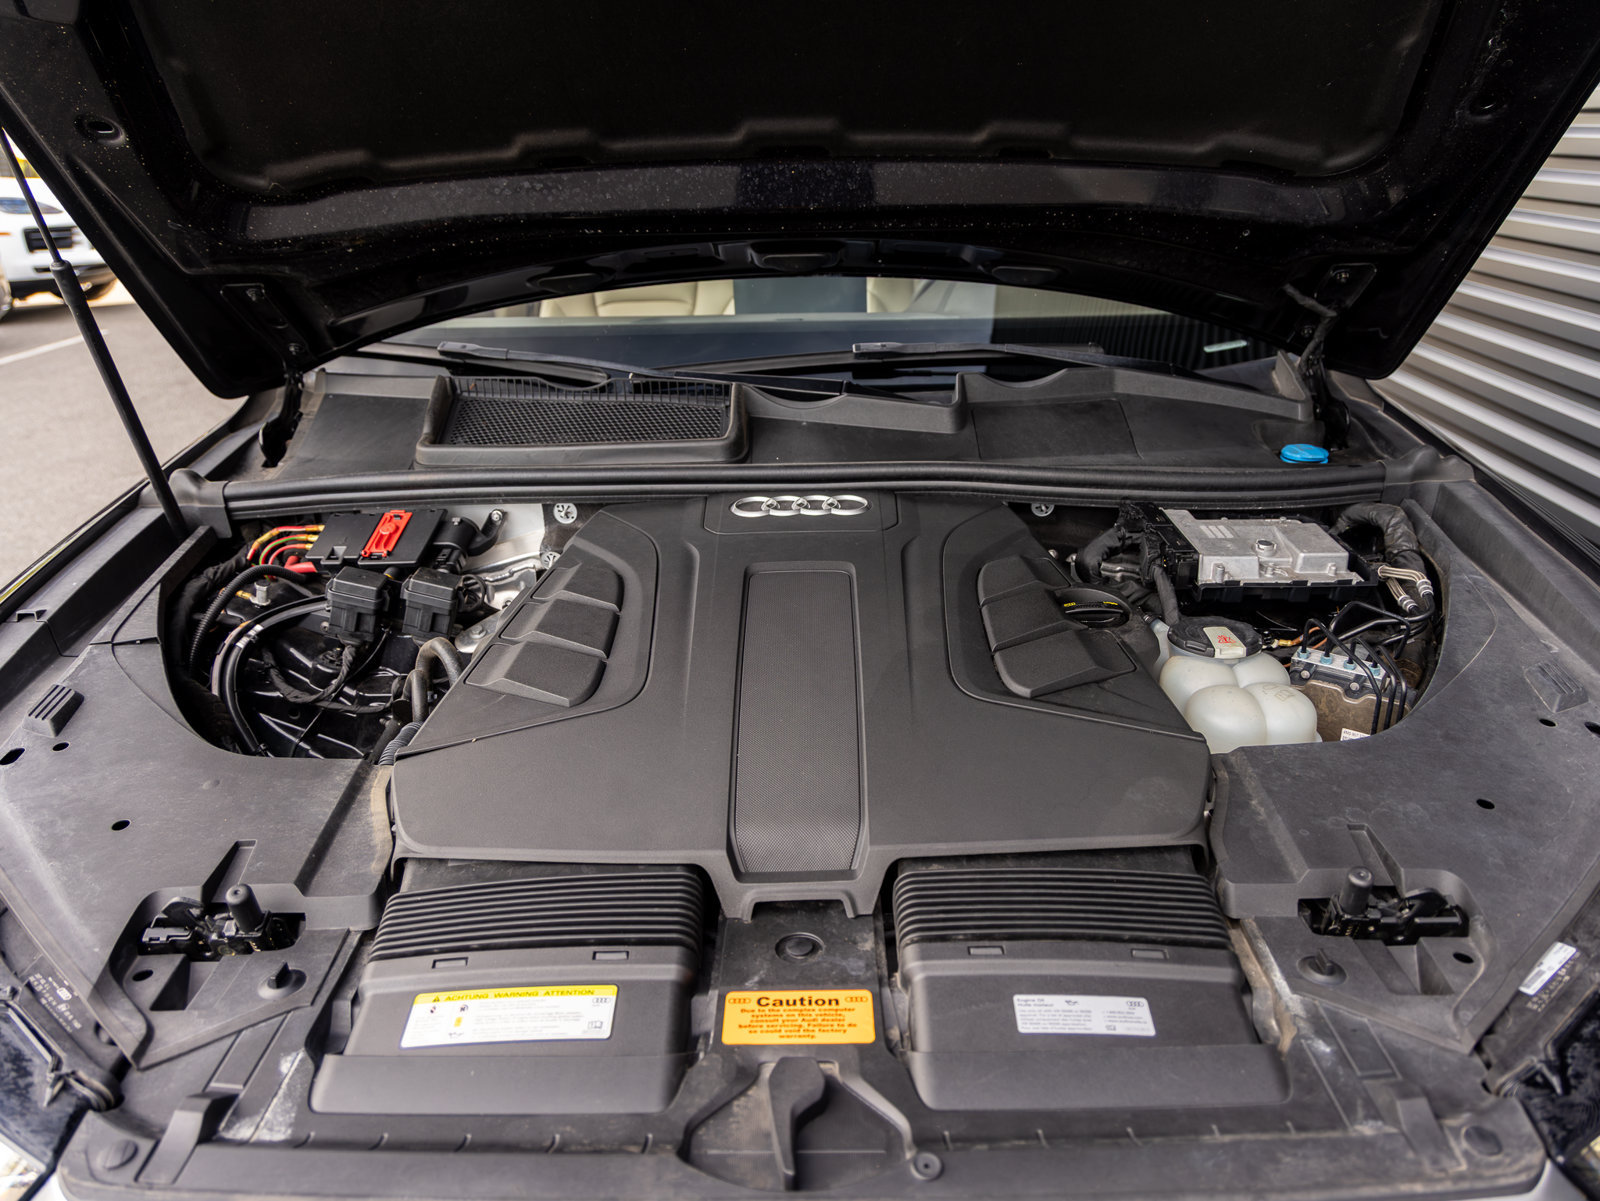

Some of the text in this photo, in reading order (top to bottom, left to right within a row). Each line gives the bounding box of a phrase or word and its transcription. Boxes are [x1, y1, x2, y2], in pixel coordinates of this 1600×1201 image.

[444, 989, 595, 1001] ACHTUNG WARNING ATTENTION
[757, 996, 839, 1006] Caution
